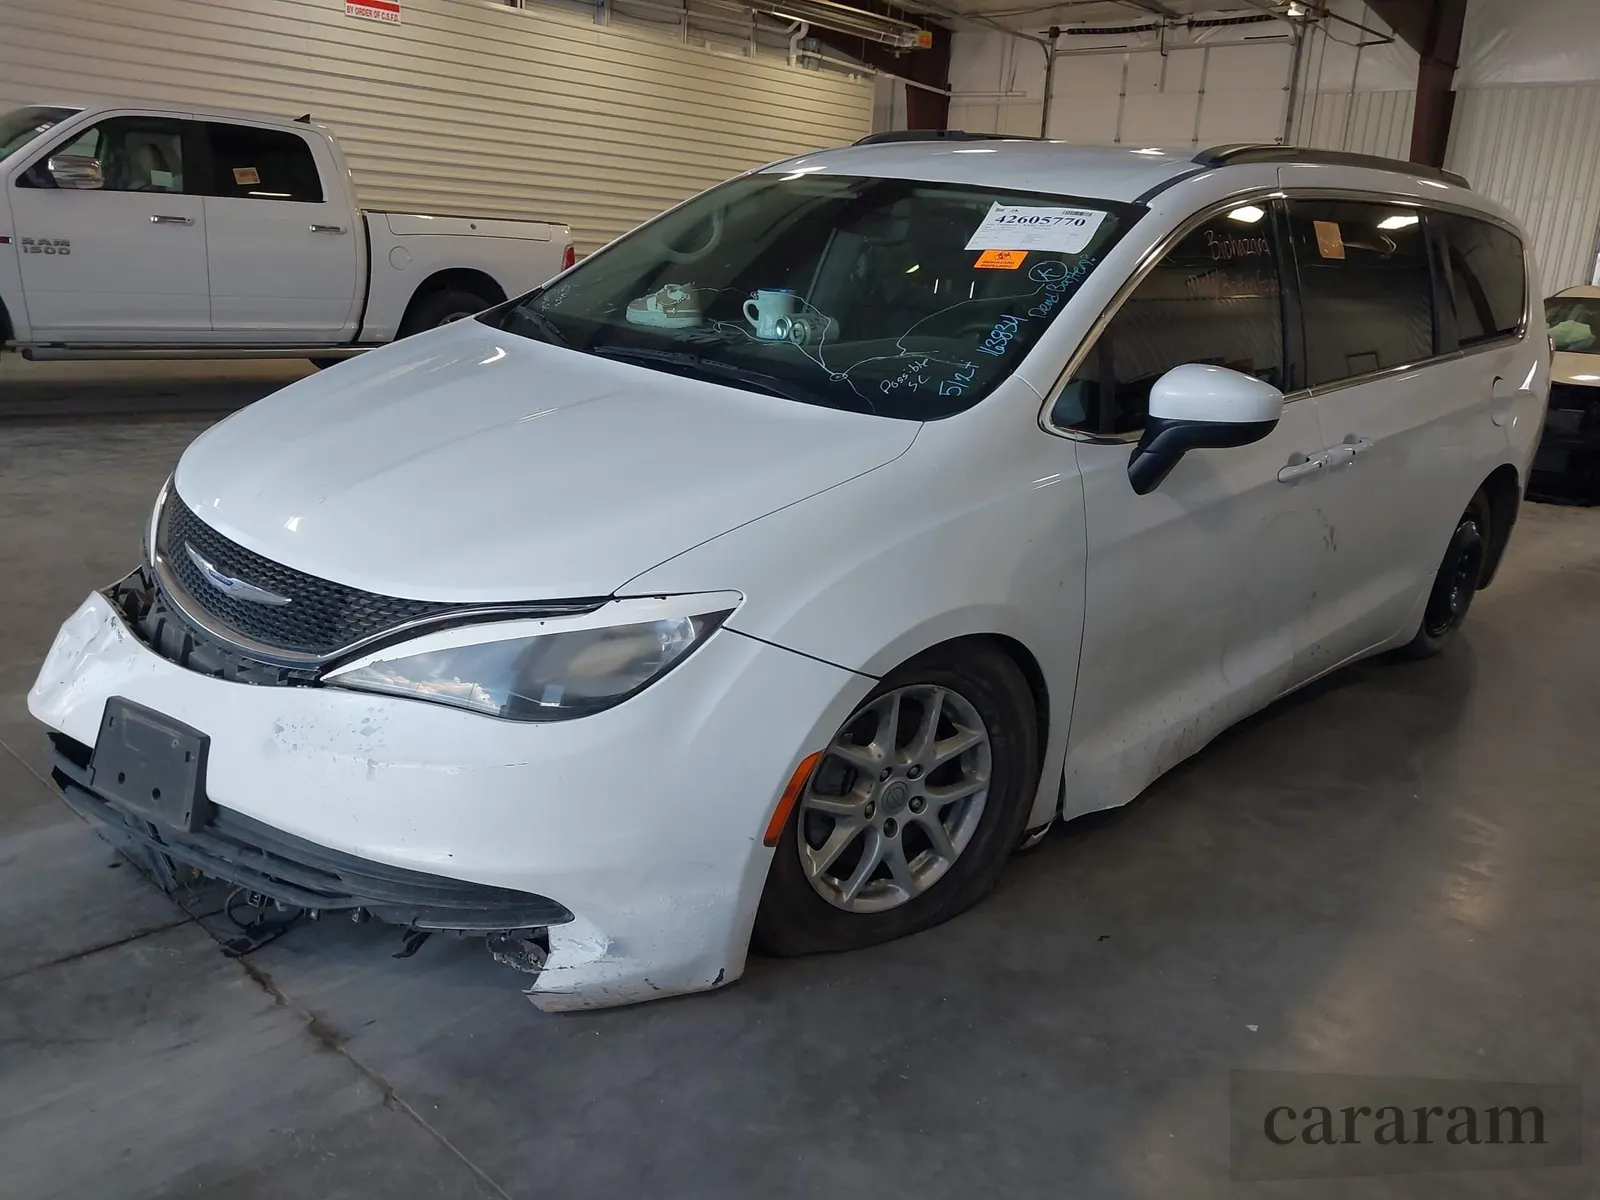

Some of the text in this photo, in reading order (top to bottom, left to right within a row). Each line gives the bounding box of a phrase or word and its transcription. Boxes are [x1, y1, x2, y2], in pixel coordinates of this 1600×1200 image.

[346, 5, 354, 14] BY
[355, 7, 373, 16] ORDER
[373, 10, 380, 18] OF
[995, 215, 1087, 227] 42605770
[22, 237, 70, 247] RAM
[1204, 229, 1271, 260] Biohazard
[22, 246, 70, 255] 1500
[1028, 293, 1060, 318] Dead
[880, 358, 929, 394] Possible
